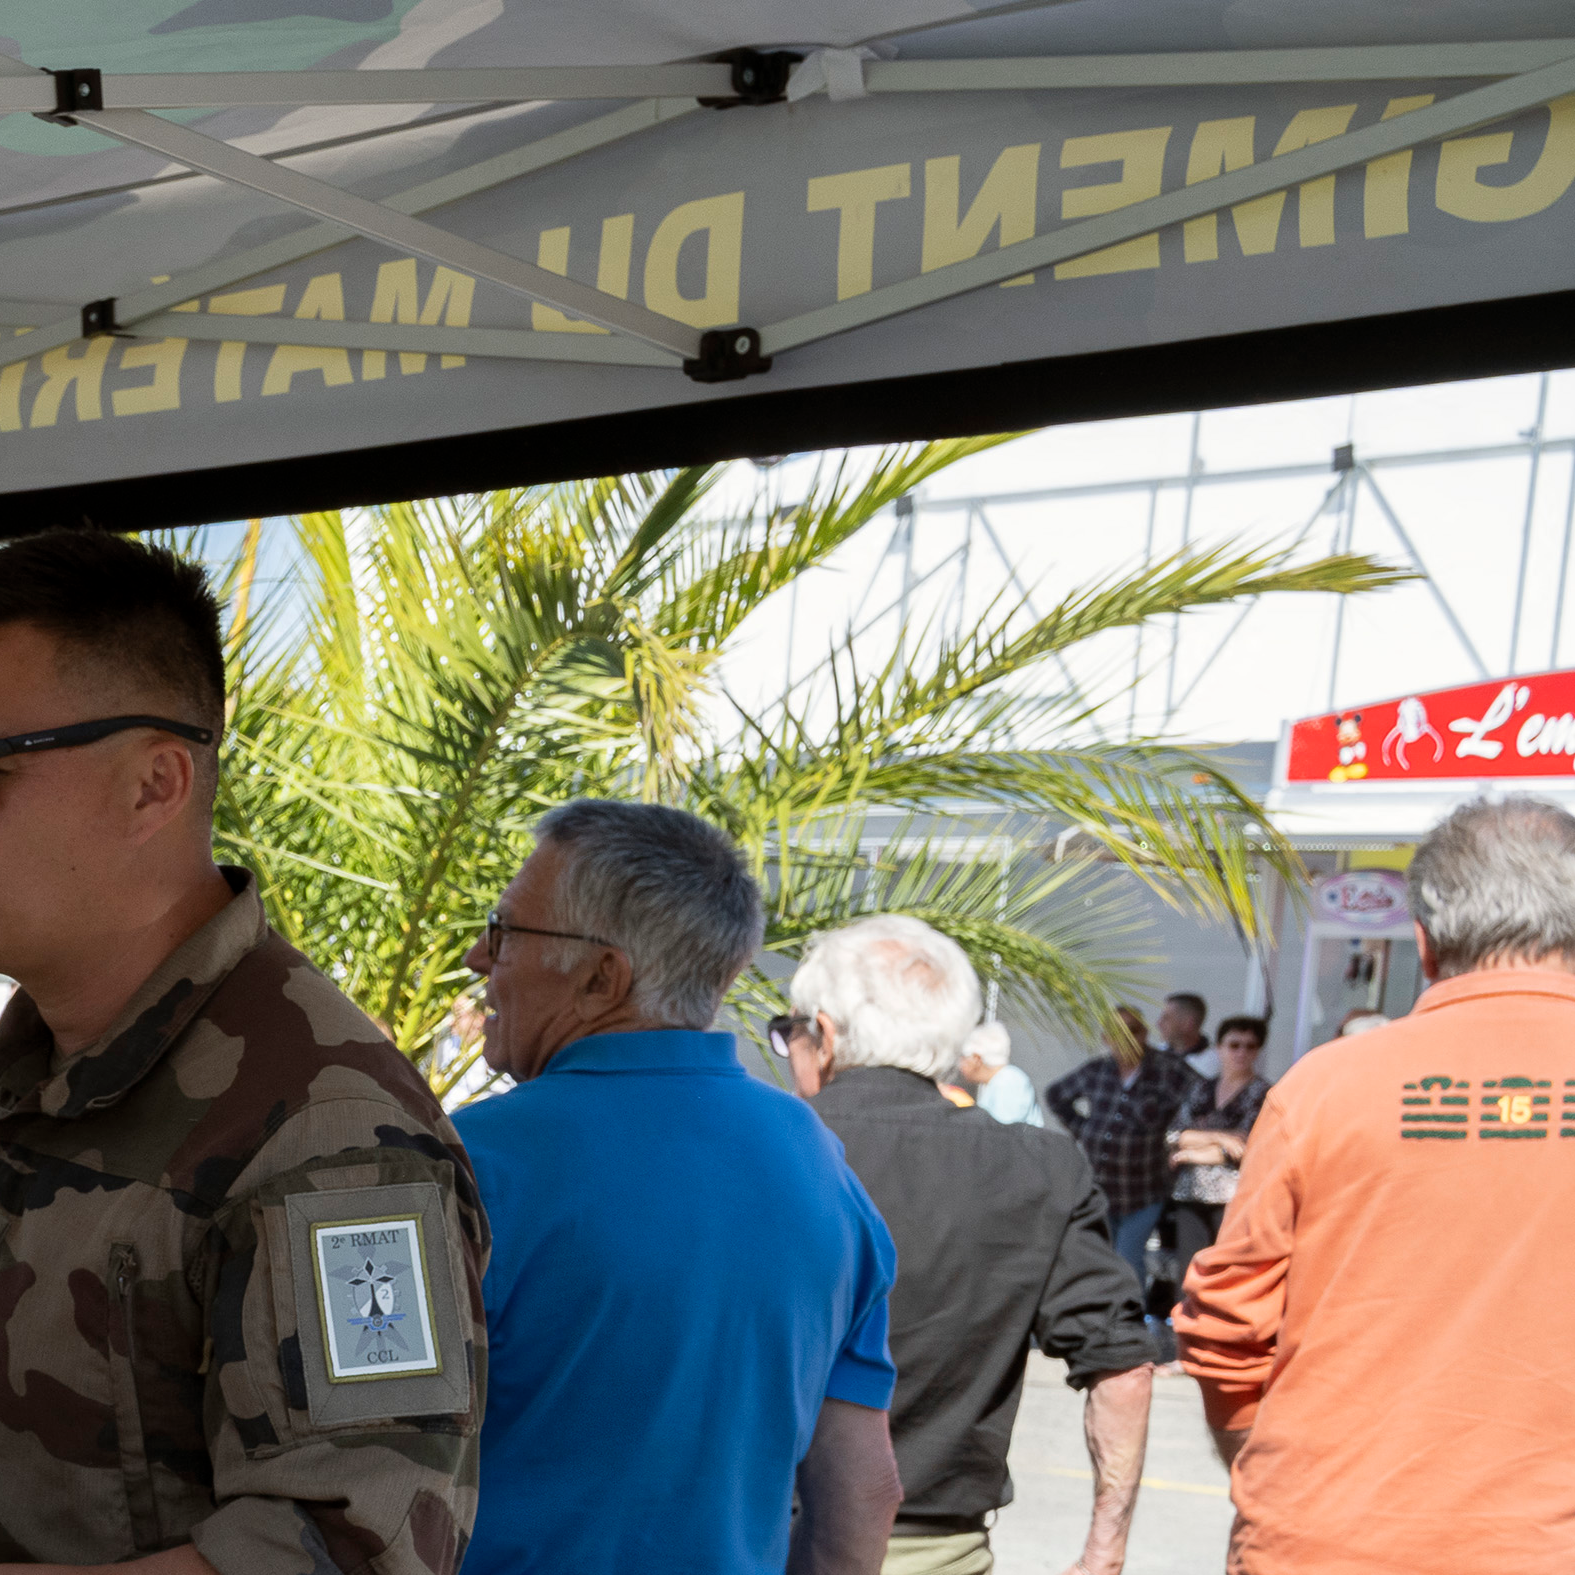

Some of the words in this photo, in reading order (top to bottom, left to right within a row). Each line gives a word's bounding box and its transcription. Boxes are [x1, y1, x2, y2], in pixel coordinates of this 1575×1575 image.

[1497, 1095, 1533, 1125] 15
[351, 1230, 399, 1247] RMAT
[367, 1350, 399, 1364] CCL
